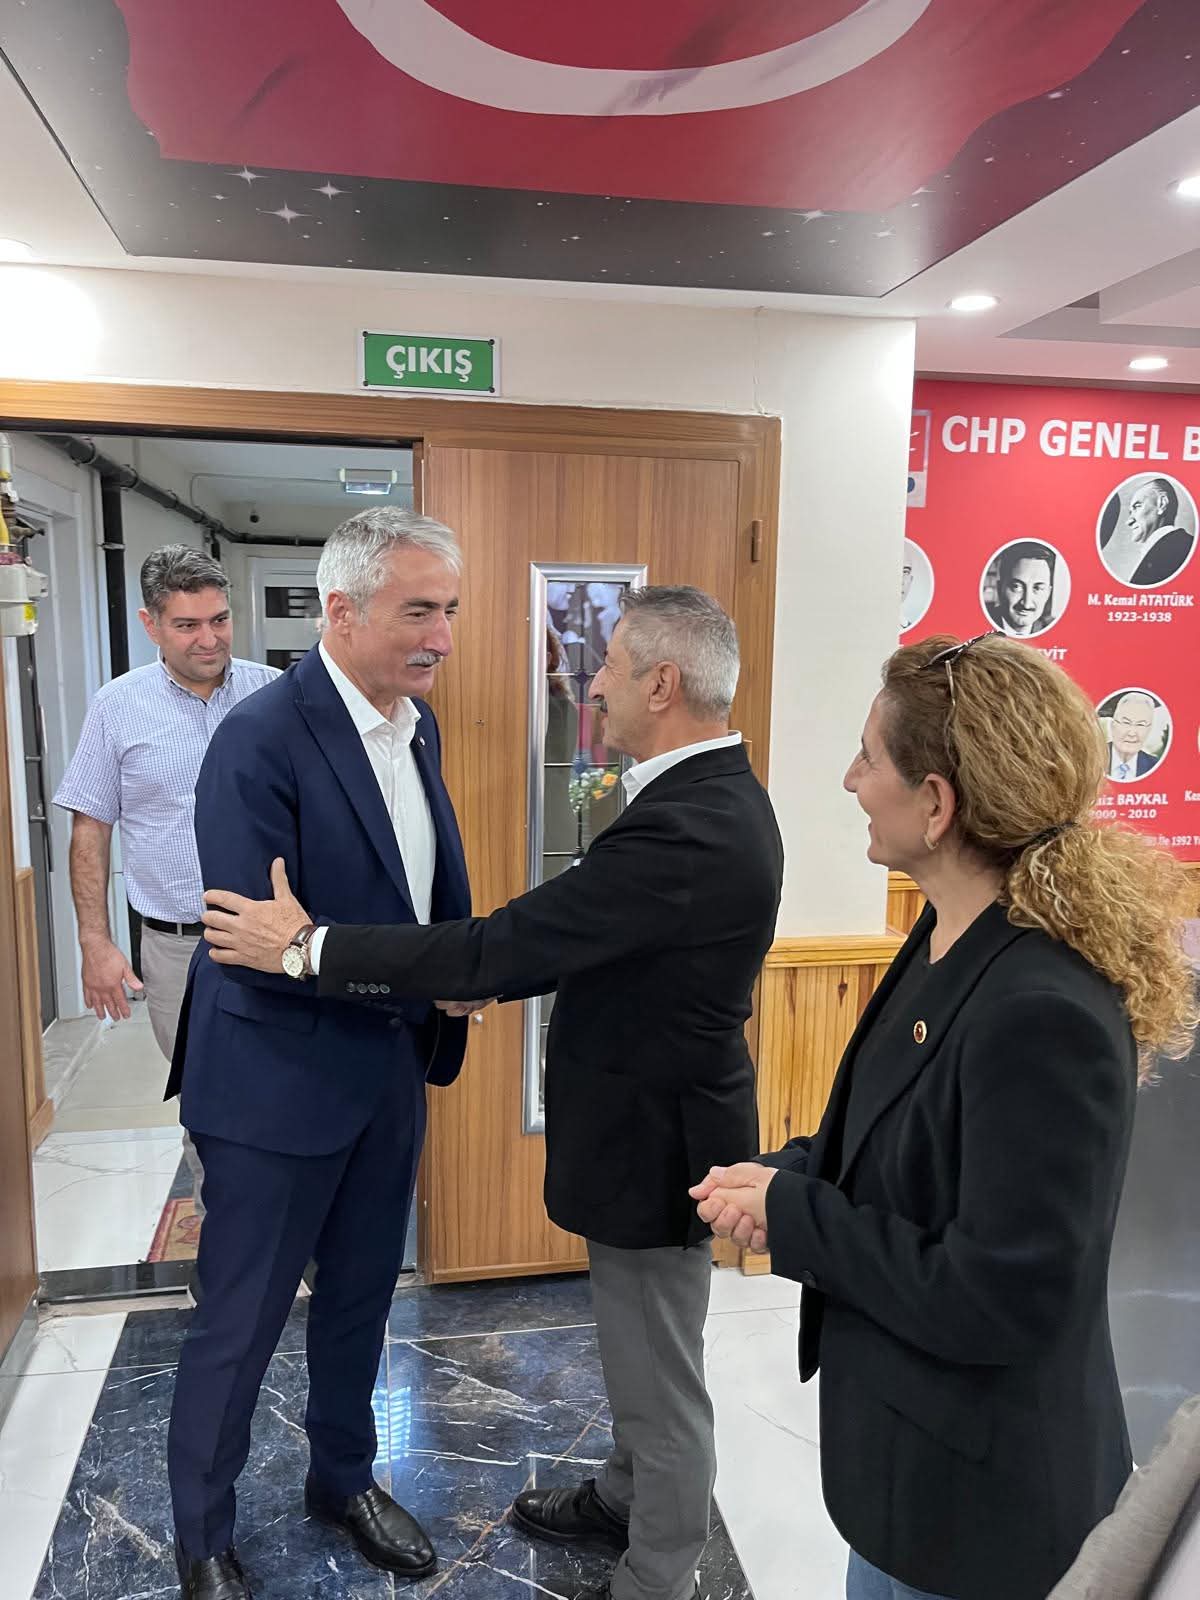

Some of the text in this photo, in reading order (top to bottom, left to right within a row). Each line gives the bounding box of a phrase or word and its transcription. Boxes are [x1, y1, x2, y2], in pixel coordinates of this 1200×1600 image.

[386, 345, 473, 383] ÇIKIŞ
[941, 415, 1200, 461] CHP GENEL B
[1087, 591, 1194, 607] M. Kemal ATATÜRK
[1107, 611, 1172, 622] 1923-1938
[1117, 793, 1169, 806] BAYKAL
[1127, 808, 1158, 819] 2010
